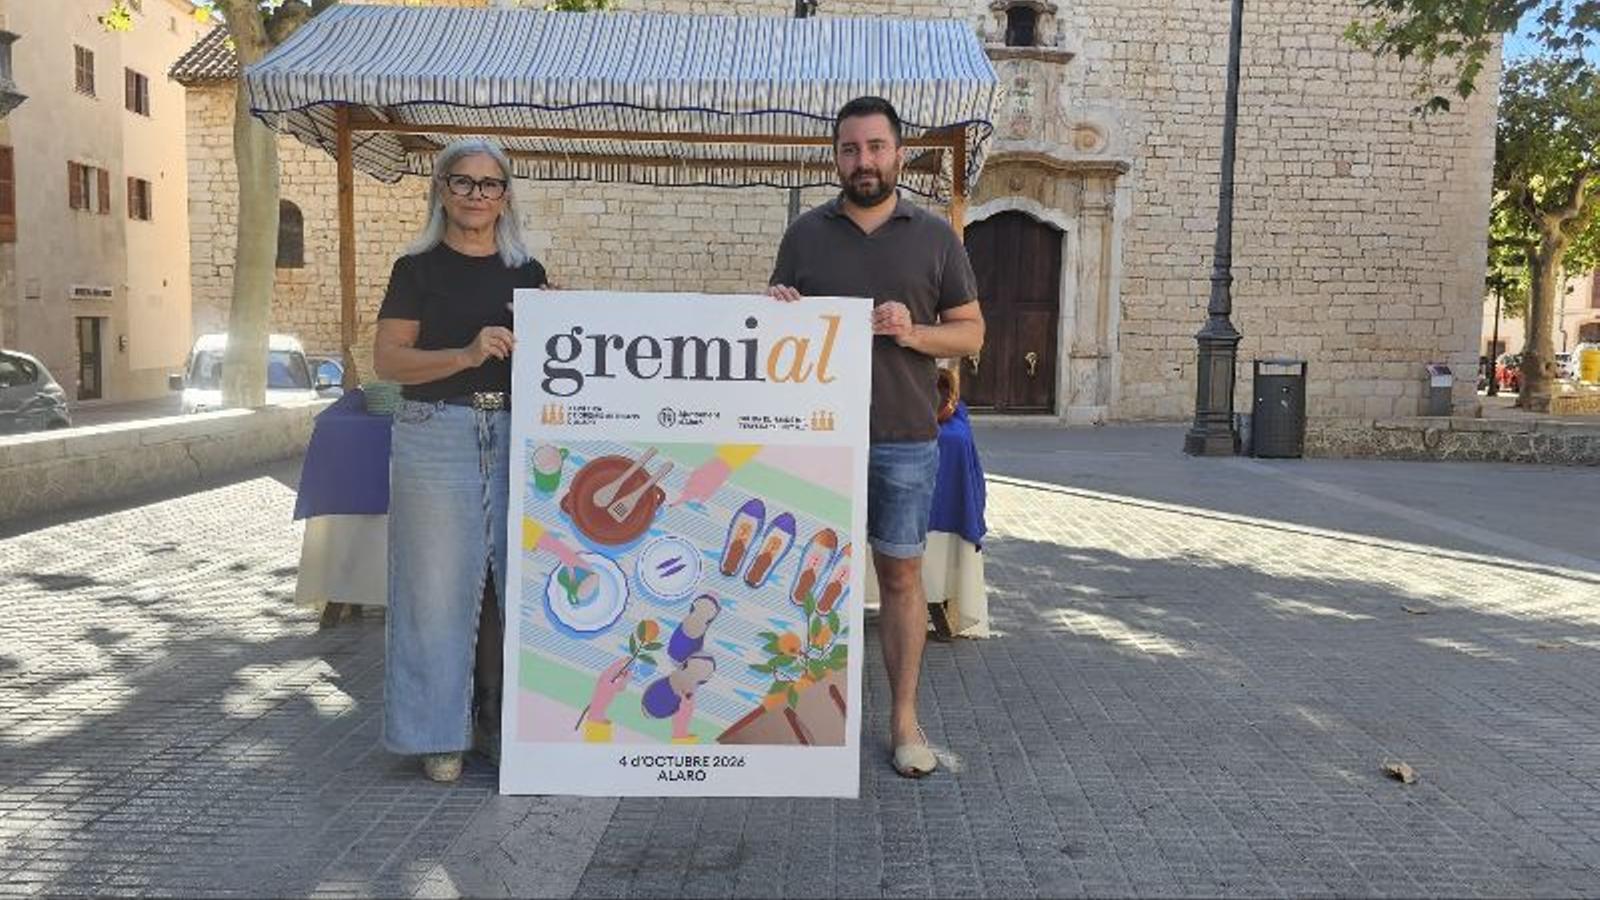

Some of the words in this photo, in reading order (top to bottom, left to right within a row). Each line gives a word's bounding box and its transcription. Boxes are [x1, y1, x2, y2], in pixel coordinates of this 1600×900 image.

[541, 315, 841, 397] gremial
[619, 756, 628, 767] 4
[631, 755, 711, 767] d'OCTUBRE
[713, 756, 746, 767] 2026
